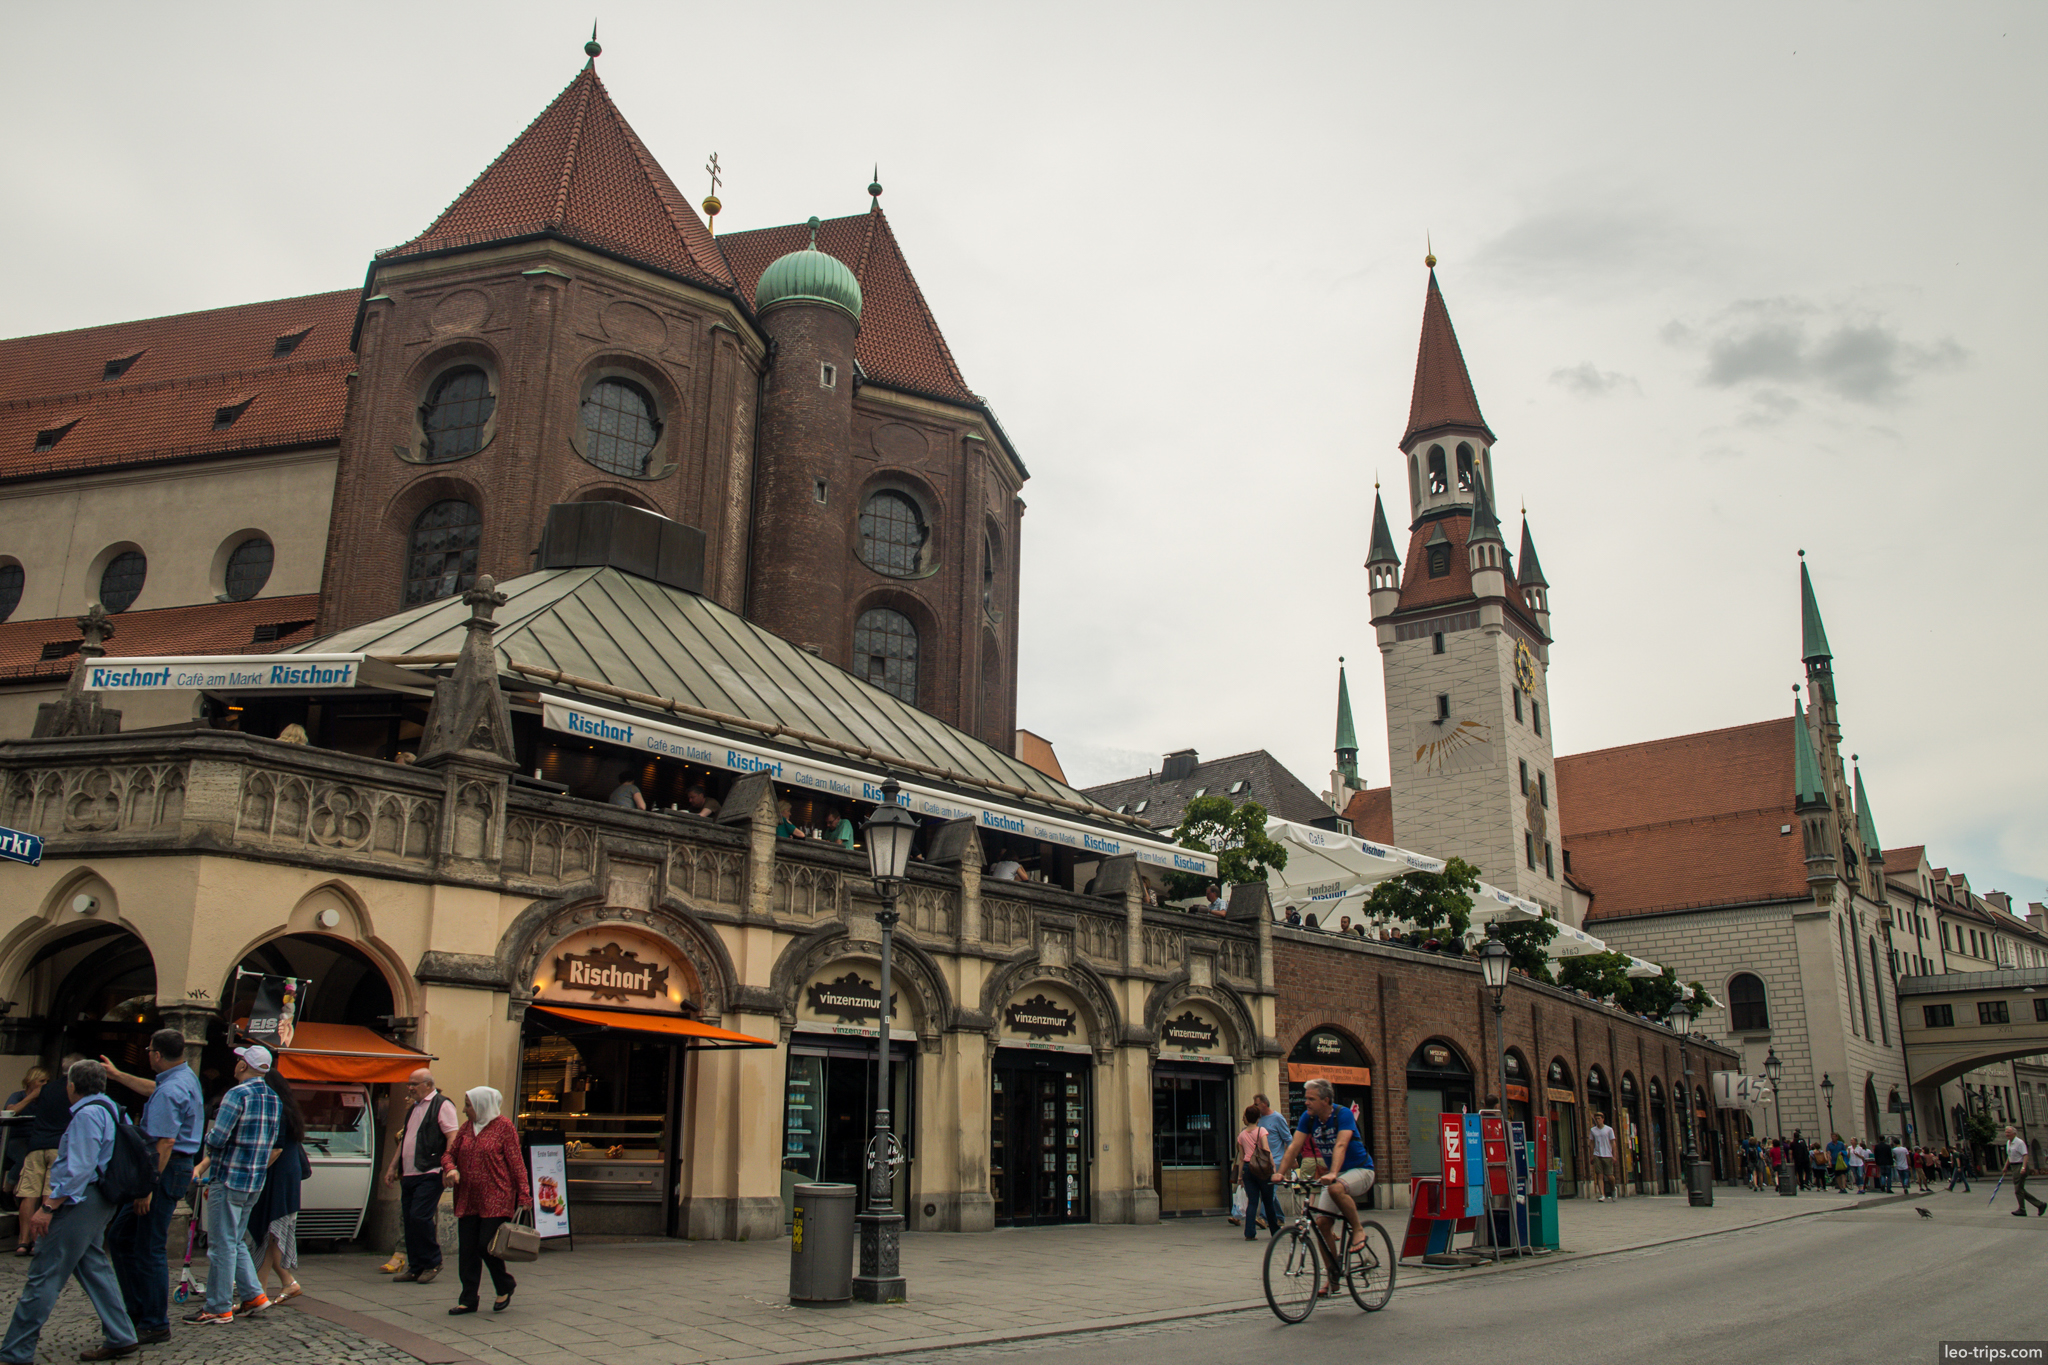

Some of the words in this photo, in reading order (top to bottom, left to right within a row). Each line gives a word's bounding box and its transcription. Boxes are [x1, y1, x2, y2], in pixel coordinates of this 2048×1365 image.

[91, 667, 172, 687] Rischart
[206, 675, 225, 686] am
[229, 672, 263, 686] Markt
[270, 664, 352, 685] Rischart
[568, 712, 634, 743] Rischart
[670, 745, 685, 756] am
[687, 746, 712, 763] Markt
[727, 750, 783, 778] Rischart
[815, 779, 827, 789] am
[829, 780, 850, 795] Markt
[863, 782, 911, 808] Risart
[941, 809, 953, 818] am
[982, 810, 1025, 833] Rischart
[1048, 831, 1058, 841] am
[1059, 831, 1075, 845] Markt
[1083, 833, 1120, 855] Rischart
[1152, 852, 1167, 866] Markt
[1174, 854, 1206, 874] Rischart
[0, 833, 31, 857] rkt
[1362, 842, 1386, 859] Rischart
[570, 960, 653, 991] Rischart
[820, 991, 881, 1009] vinzenzmur
[249, 1017, 278, 1030] EIS
[1014, 1011, 1068, 1026] vinzenzmurr
[1169, 1026, 1211, 1040] vinzenzmurr
[1025, 1040, 1064, 1051] vinzenzmurr
[1444, 1125, 1461, 1159] tz
